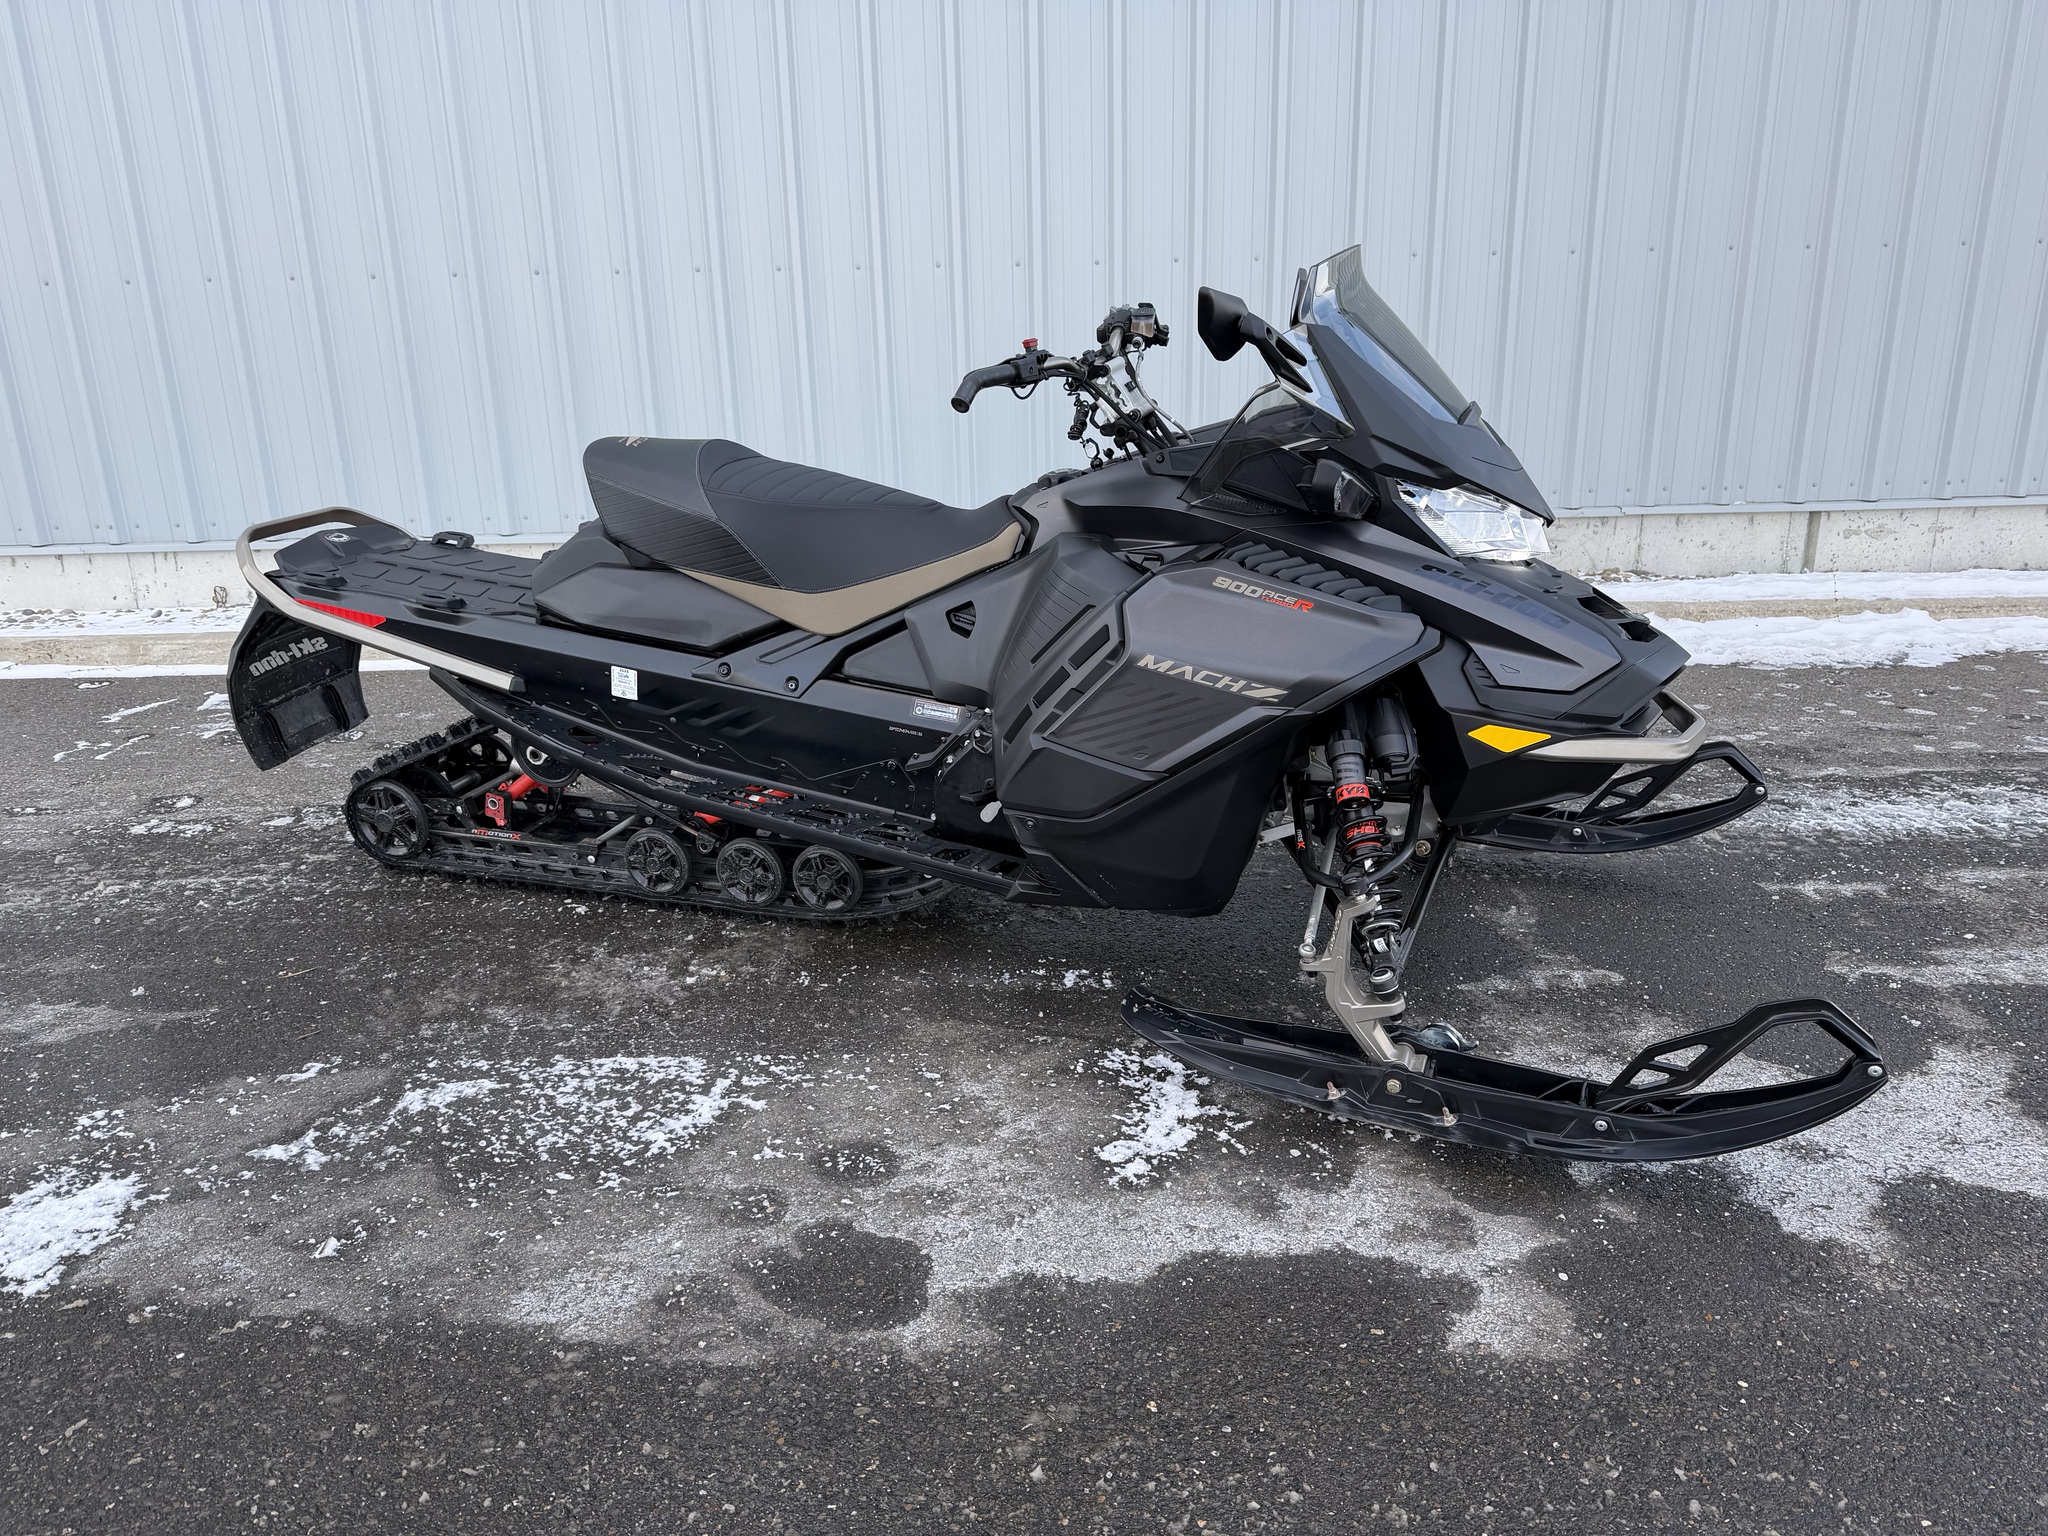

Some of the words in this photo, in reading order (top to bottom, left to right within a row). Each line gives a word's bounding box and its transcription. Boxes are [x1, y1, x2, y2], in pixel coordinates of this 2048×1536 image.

[1212, 576, 1264, 598] 900
[1262, 590, 1298, 604] ACE
[1260, 595, 1294, 608] TURBO
[1415, 564, 1571, 629] ski-doo
[1137, 654, 1248, 692] MACH
